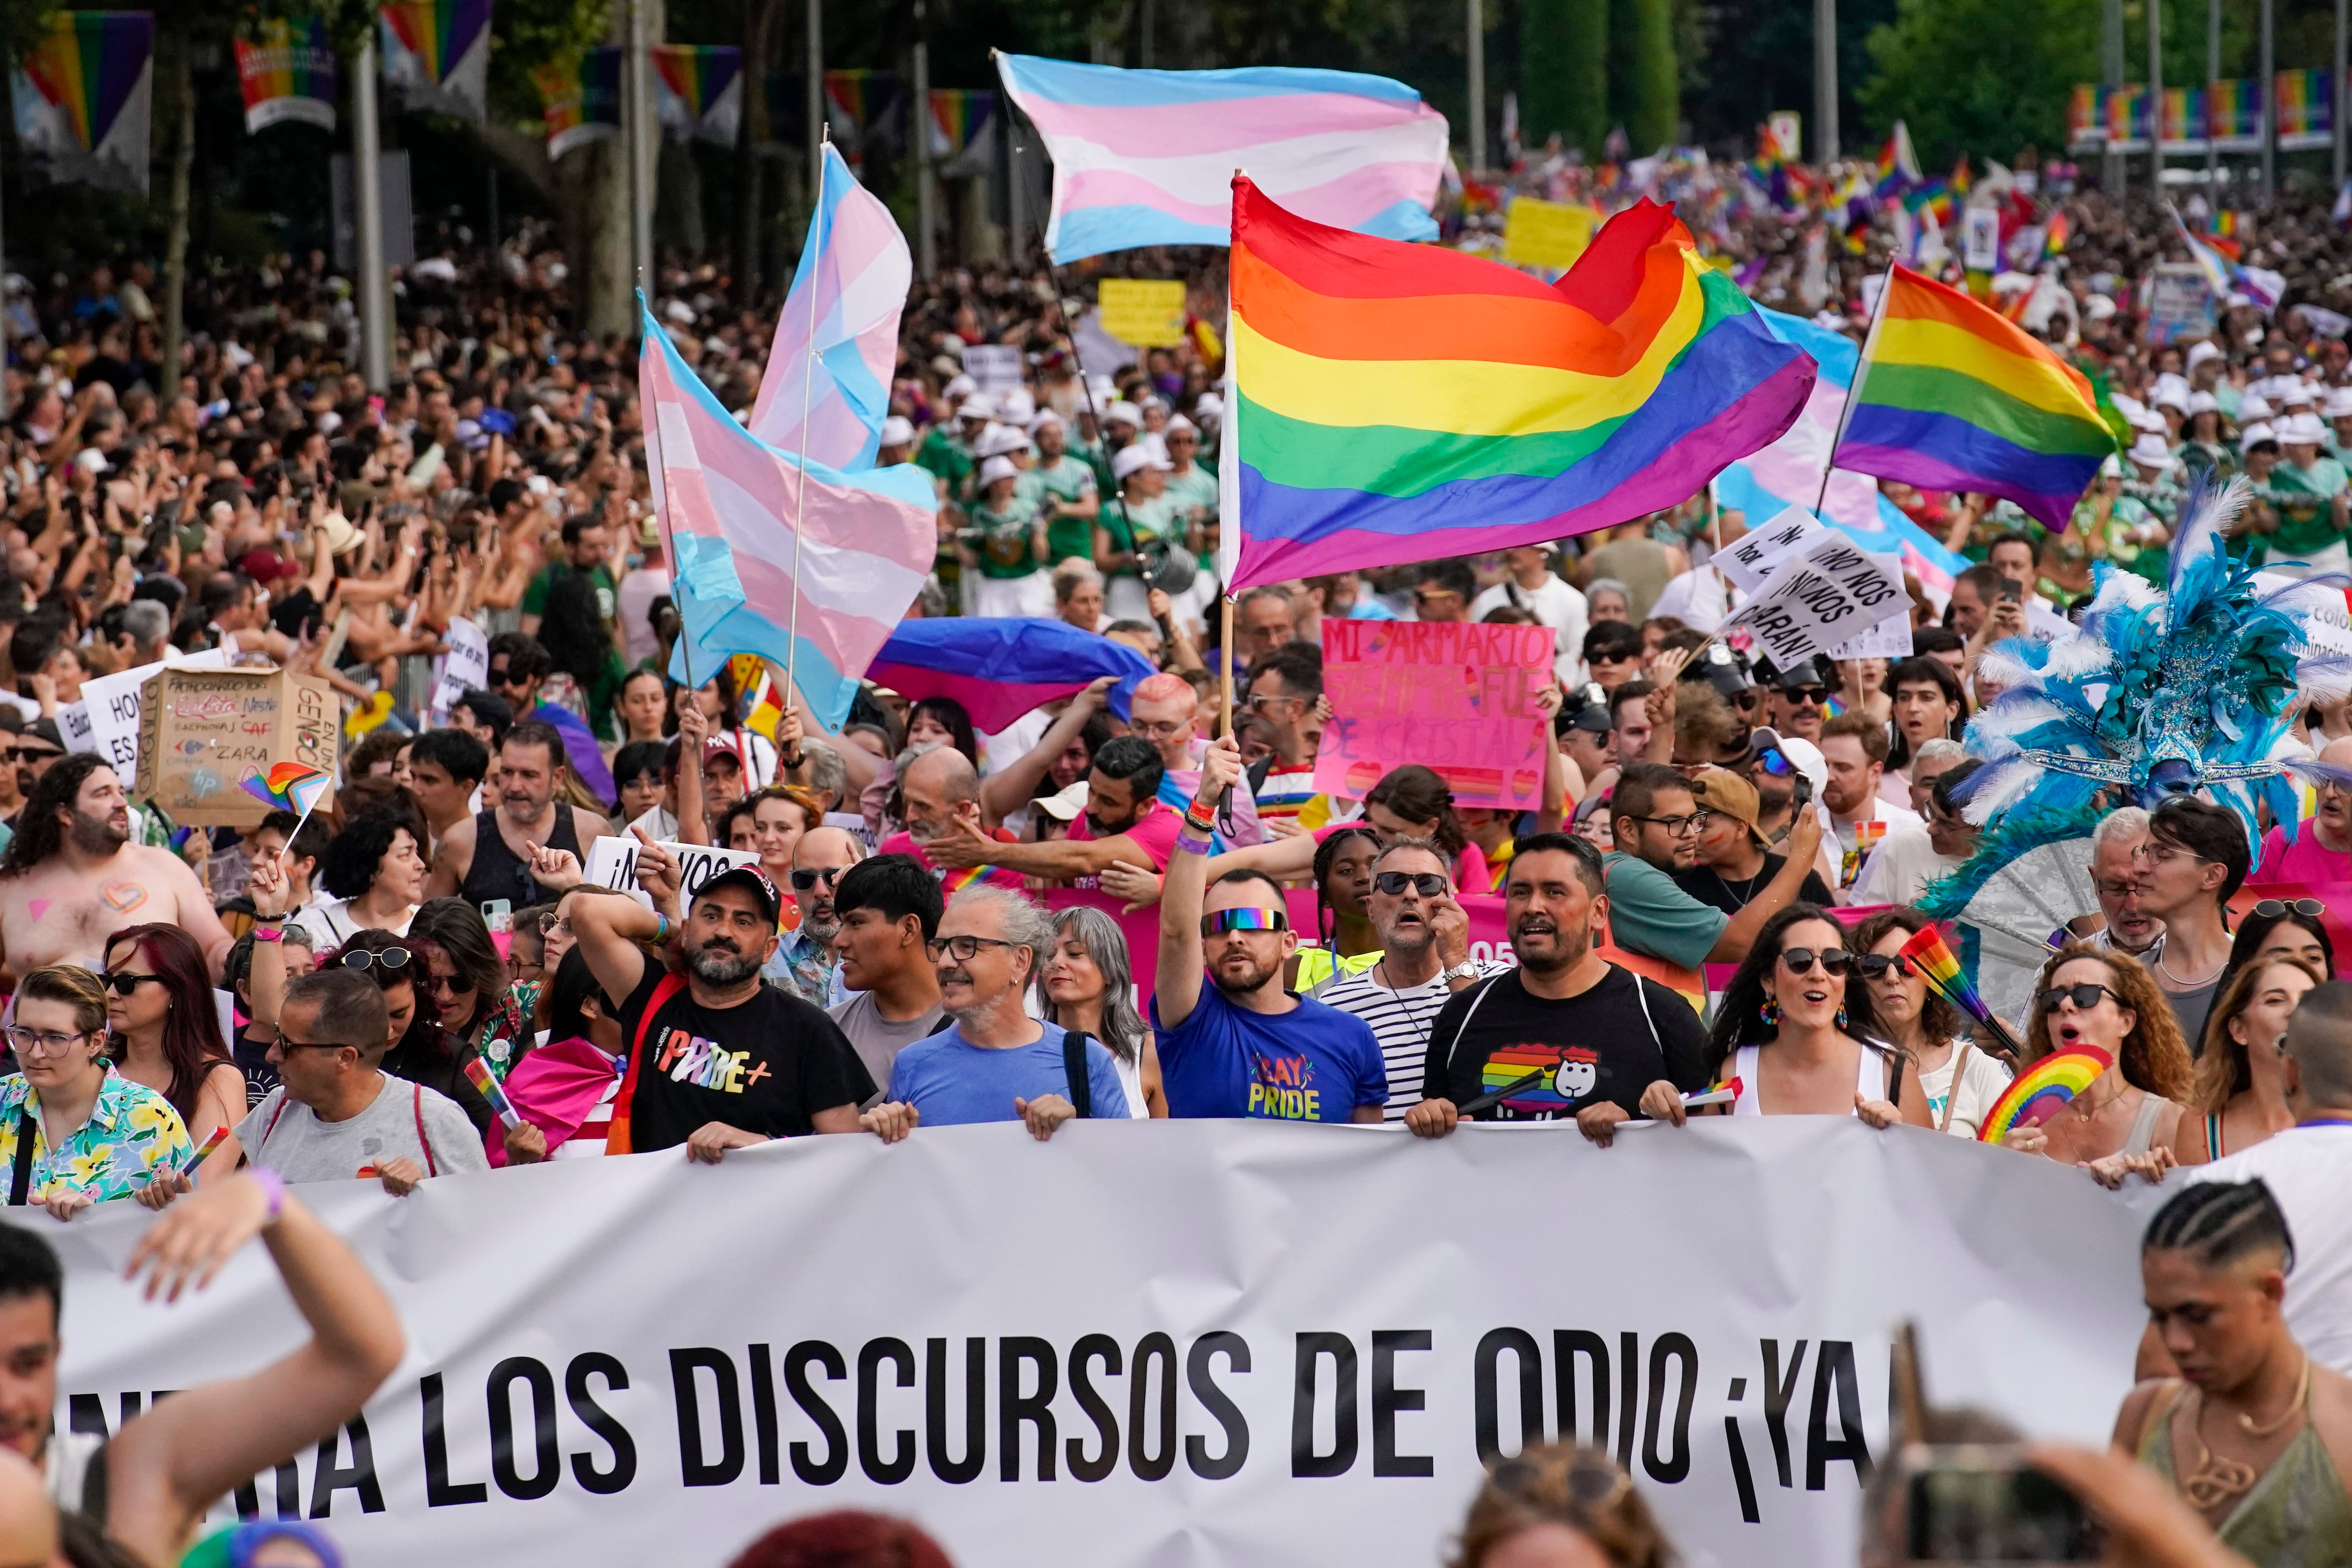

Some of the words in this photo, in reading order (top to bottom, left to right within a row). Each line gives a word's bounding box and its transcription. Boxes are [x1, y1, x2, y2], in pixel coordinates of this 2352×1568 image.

[1800, 583, 1856, 624] NOS
[1842, 569, 1897, 607] NOS
[2314, 607, 2349, 629] colo
[1322, 619, 1363, 662] MI
[1385, 621, 1550, 669] ARMARIO
[1481, 665, 1543, 720] FUE
[295, 686, 323, 768] GENOCI
[321, 721, 335, 742] EN
[110, 735, 135, 765] ES
[216, 745, 269, 762] ZARA
[320, 747, 334, 772] UN
[194, 769, 217, 798] hp
[610, 847, 644, 892] ¡N
[1261, 1057, 1303, 1086] GAY
[1248, 1082, 1320, 1121] PRIDE
[420, 1351, 637, 1508] LOS
[668, 1331, 1251, 1488] DISCURSOS
[1291, 1330, 1434, 1478] DE
[1472, 1326, 1699, 1484] ODIO
